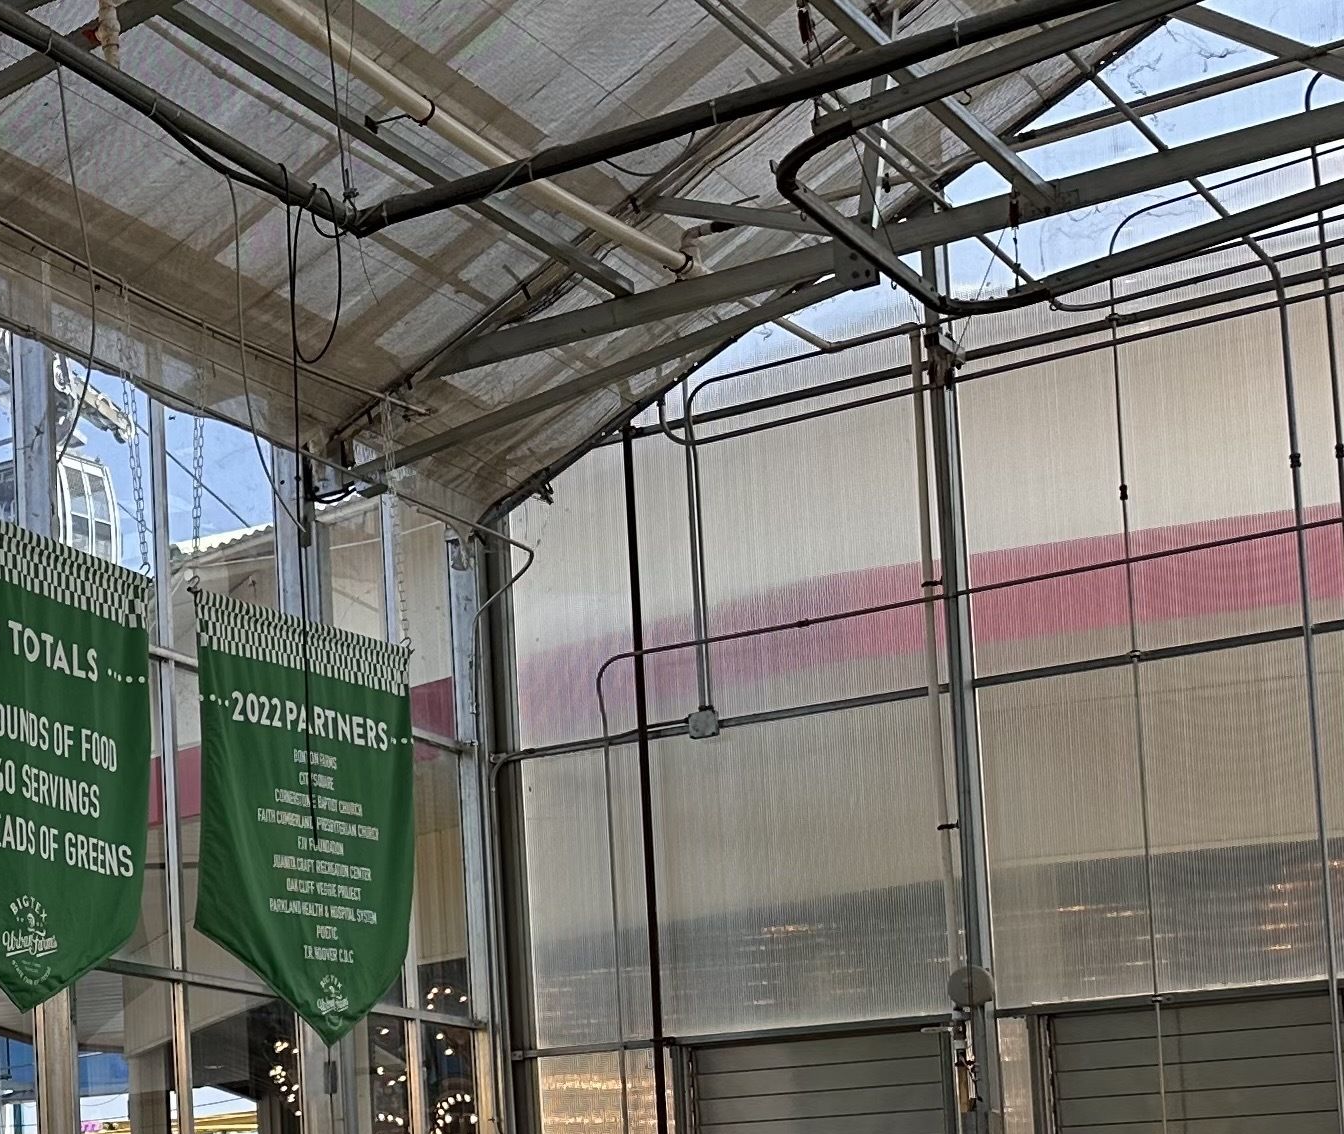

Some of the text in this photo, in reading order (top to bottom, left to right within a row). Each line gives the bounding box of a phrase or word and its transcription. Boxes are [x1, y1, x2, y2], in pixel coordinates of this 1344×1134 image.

[8, 619, 98, 682] TOTALS
[53, 721, 74, 758] OF
[81, 728, 117, 773] FOOD
[231, 690, 389, 751] 2022 PARTNERS
[21, 764, 100, 819] SERVINGS
[39, 825, 59, 861] OF
[65, 832, 134, 877] GREENS
[9, 894, 30, 915] BIG
